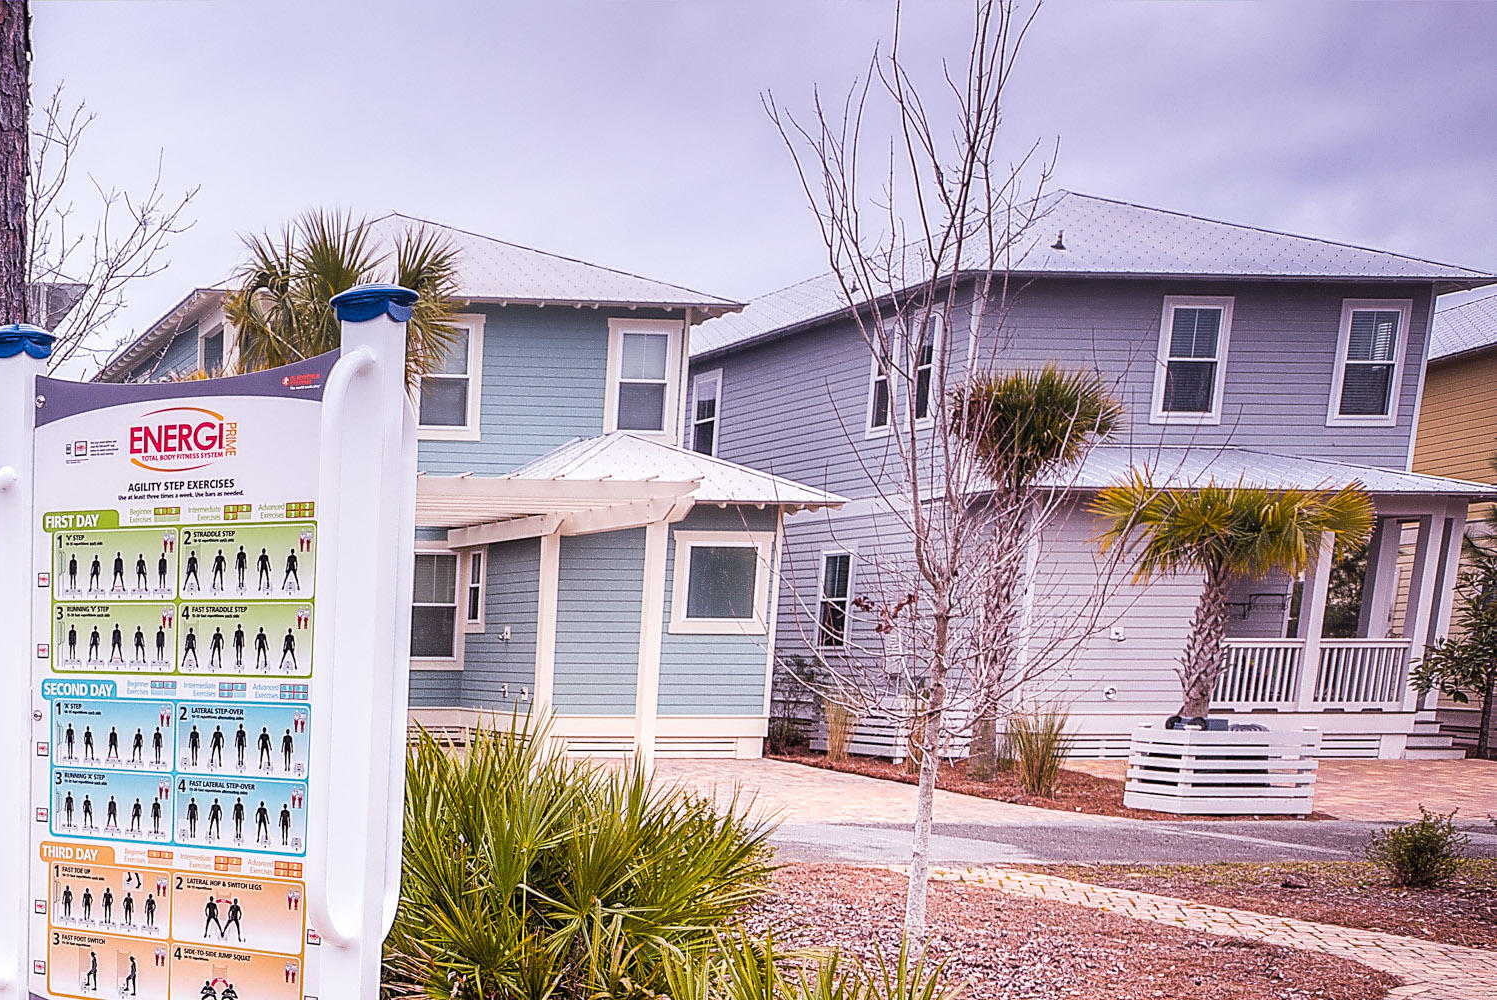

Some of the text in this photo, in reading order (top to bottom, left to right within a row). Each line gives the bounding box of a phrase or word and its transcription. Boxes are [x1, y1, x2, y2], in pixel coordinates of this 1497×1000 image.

[130, 422, 223, 454] ENERGI
[225, 422, 237, 456] PRIME
[128, 479, 234, 492] AGILITY STEP EXERCISES
[46, 514, 99, 528] FIRST DAY
[57, 535, 62, 548] 1
[184, 531, 191, 544] 2
[57, 606, 63, 619] 3
[182, 606, 189, 619] 4
[44, 682, 113, 697] SECOND DAY
[56, 702, 61, 715] 1
[180, 707, 187, 720] 2
[56, 772, 62, 784] 3
[178, 780, 186, 792] 4
[226, 782, 255, 790] STEP-OVER
[42, 845, 98, 861] THIRD DAY
[248, 859, 274, 867] Advanced
[54, 865, 59, 877] 1
[250, 867, 273, 875] Exercises
[176, 877, 183, 890] 2
[53, 933, 60, 945] 3
[174, 947, 182, 960] 4
[184, 948, 217, 958] SIDE-TO-SIDE
